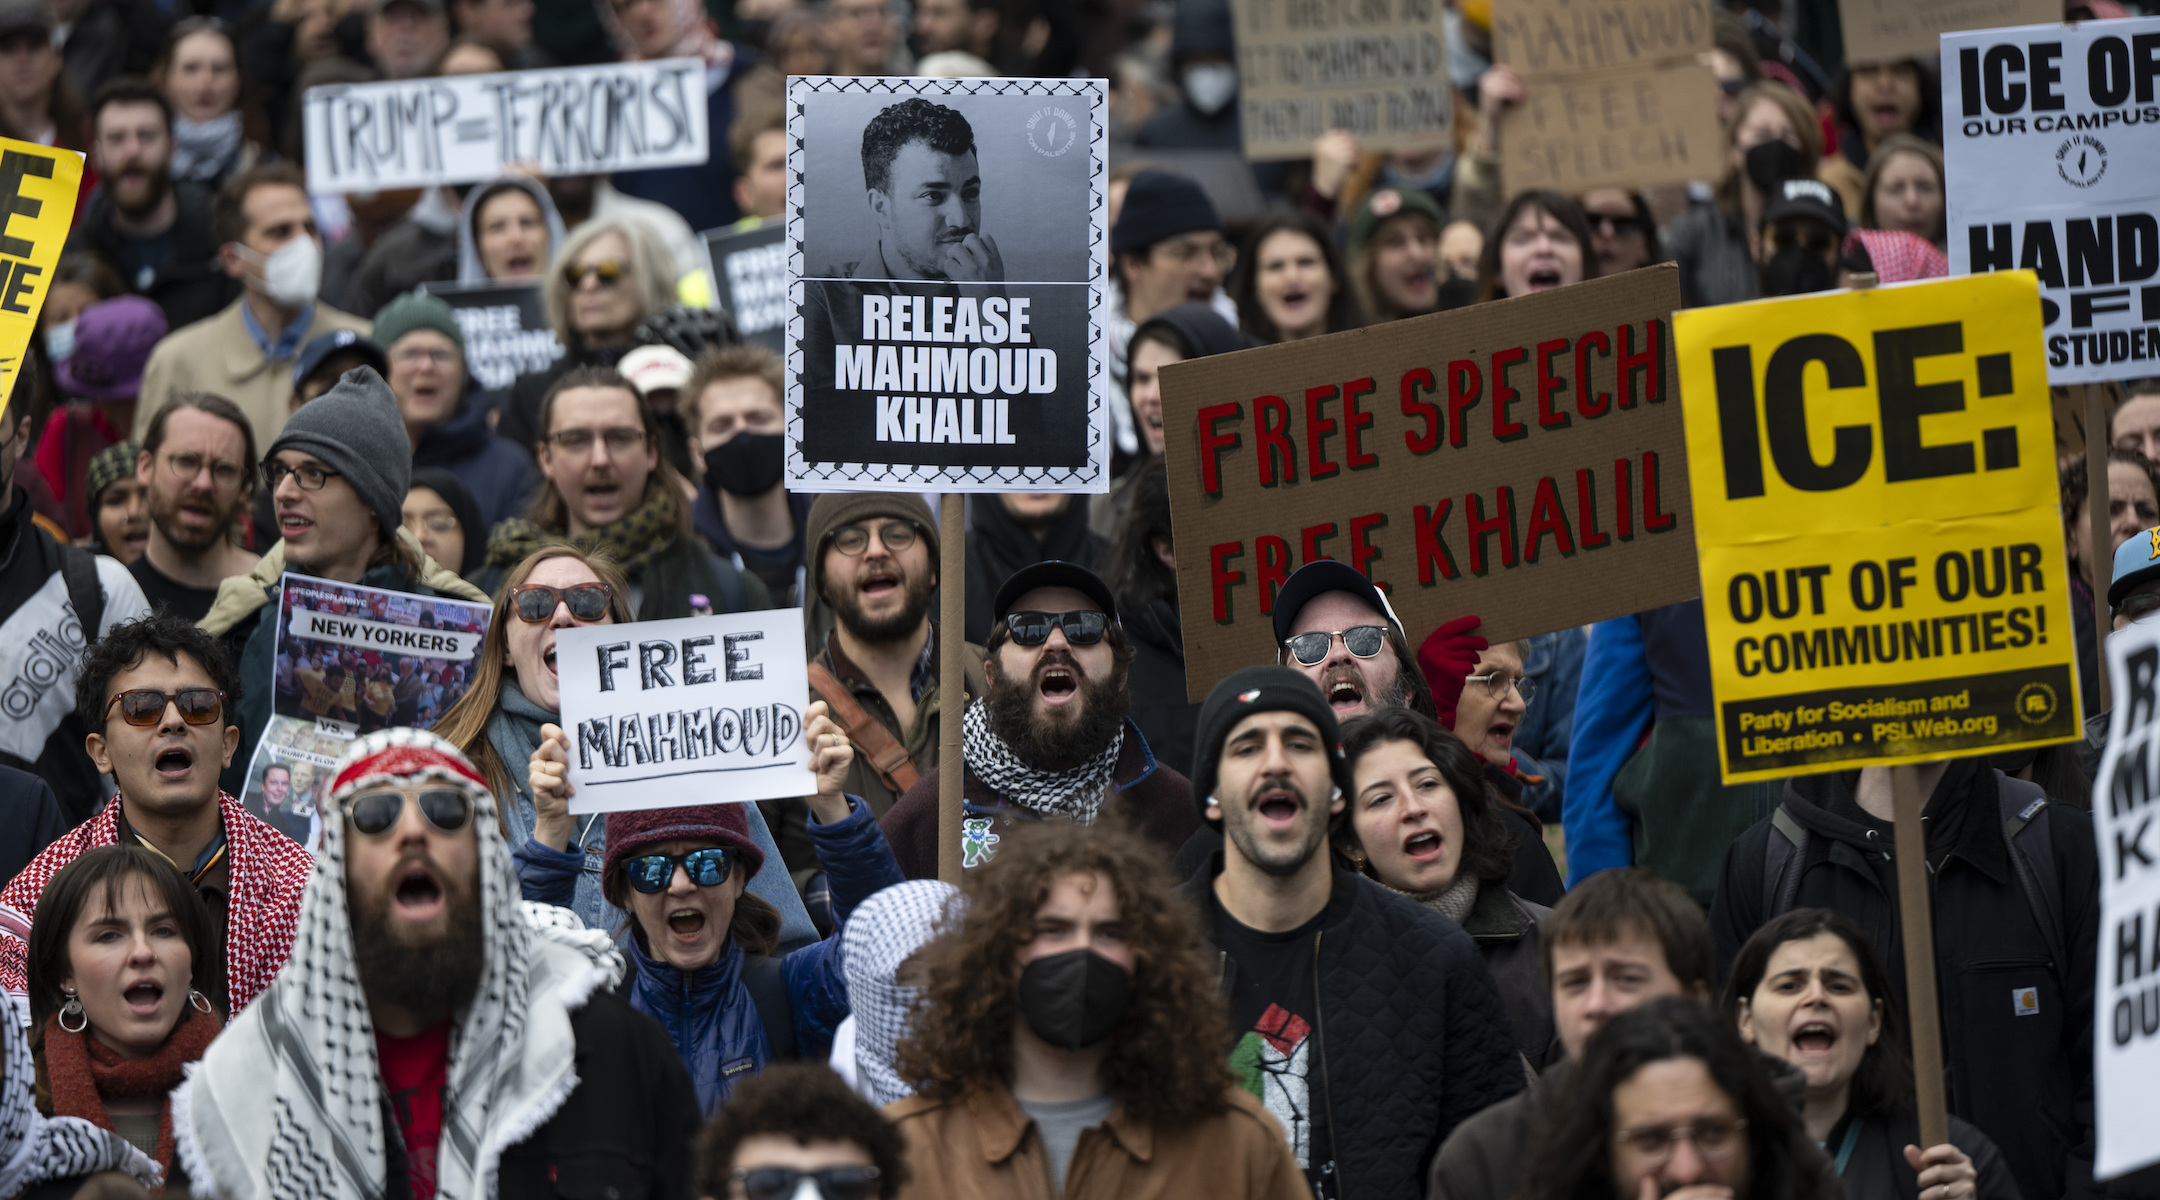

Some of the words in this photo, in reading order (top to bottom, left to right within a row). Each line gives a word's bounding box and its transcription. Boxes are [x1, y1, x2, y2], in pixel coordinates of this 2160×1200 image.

[1303, 31, 1443, 84] MAHMOUD
[1494, 1, 1708, 70] MAHMOUD
[1960, 41, 2065, 118] ICE
[1026, 109, 1043, 130] SHUT
[1043, 106, 1051, 116] IT
[1053, 106, 1077, 130] DOWN!
[1962, 118, 2027, 138] OUR
[2033, 106, 2160, 133] CAMPUS
[1027, 132, 1039, 151] FOR
[1037, 131, 1077, 157] PALESTINE
[1519, 126, 1690, 183] SPEECH
[862, 294, 1032, 344] RELEASE
[835, 344, 1058, 394] MAHMOUD
[876, 396, 1017, 444] KHALIL
[1197, 376, 1380, 499] FREE
[1400, 318, 1666, 456] SPEECH
[1711, 321, 2020, 501] ICE:
[1413, 450, 1677, 589] KHALIL
[1728, 564, 1832, 624] OUT
[1849, 556, 1918, 612] OF
[1935, 542, 2045, 604] OUR
[311, 617, 358, 639] NEW
[361, 626, 459, 653] YORKERS
[1734, 604, 2049, 677] COMMUNITIES!
[597, 630, 764, 692] FREE
[319, 720, 345, 736] VS.
[578, 703, 800, 770] MAHMOUD
[1739, 711, 1793, 733] Party
[1796, 707, 1826, 727] for
[1828, 697, 1927, 720] Socialism
[1930, 690, 1969, 711] and
[1742, 729, 1843, 757] Liberation
[1872, 715, 1998, 743] PSLWeb.org
[276, 748, 305, 761] TRUMP
